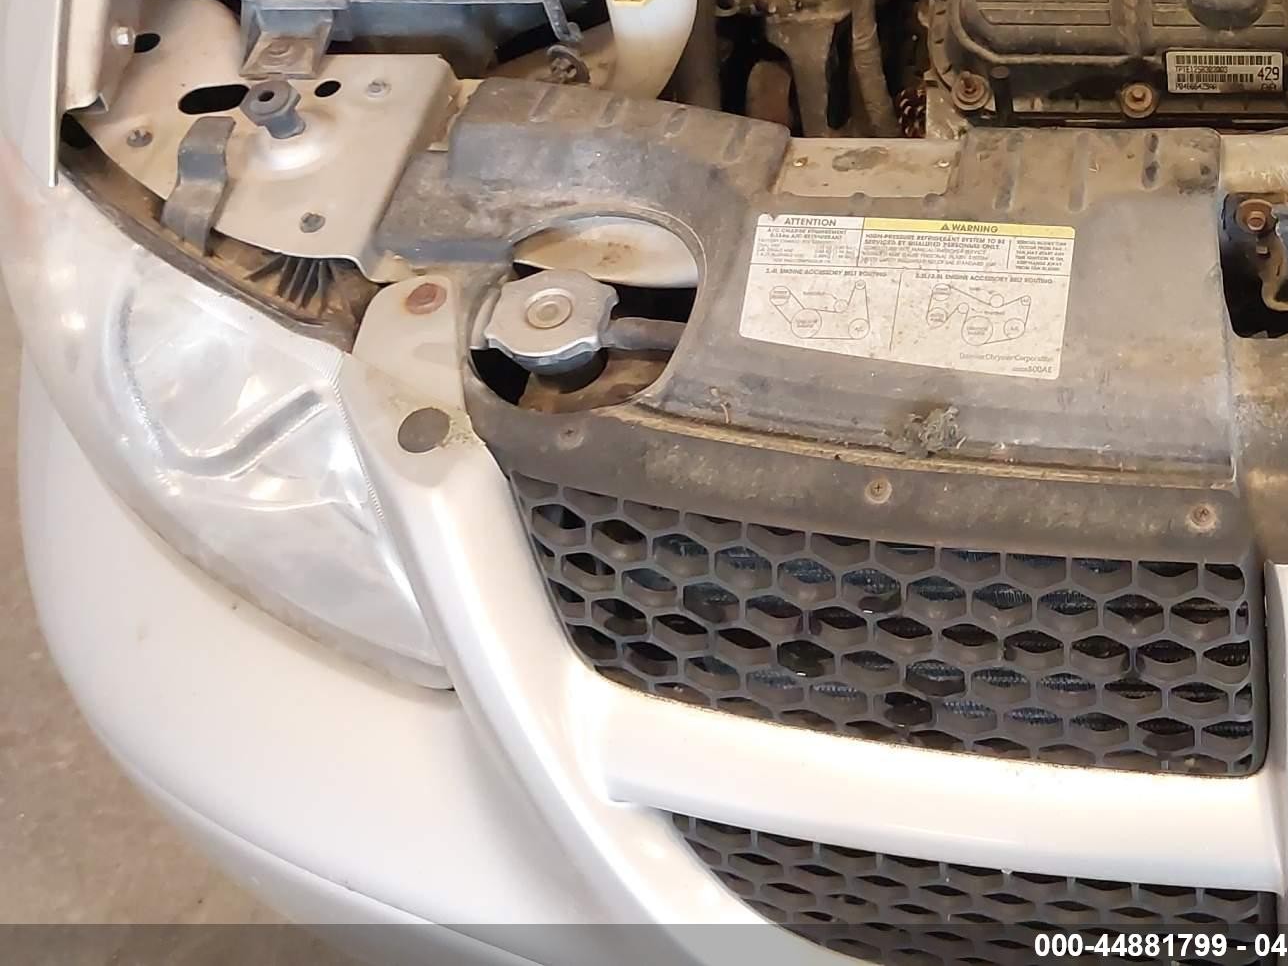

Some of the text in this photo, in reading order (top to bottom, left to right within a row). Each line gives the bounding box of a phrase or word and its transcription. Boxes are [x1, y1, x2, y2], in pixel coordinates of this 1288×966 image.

[1257, 66, 1280, 81] 429
[784, 218, 836, 226] ATTENTION
[952, 224, 998, 233] WARNING
